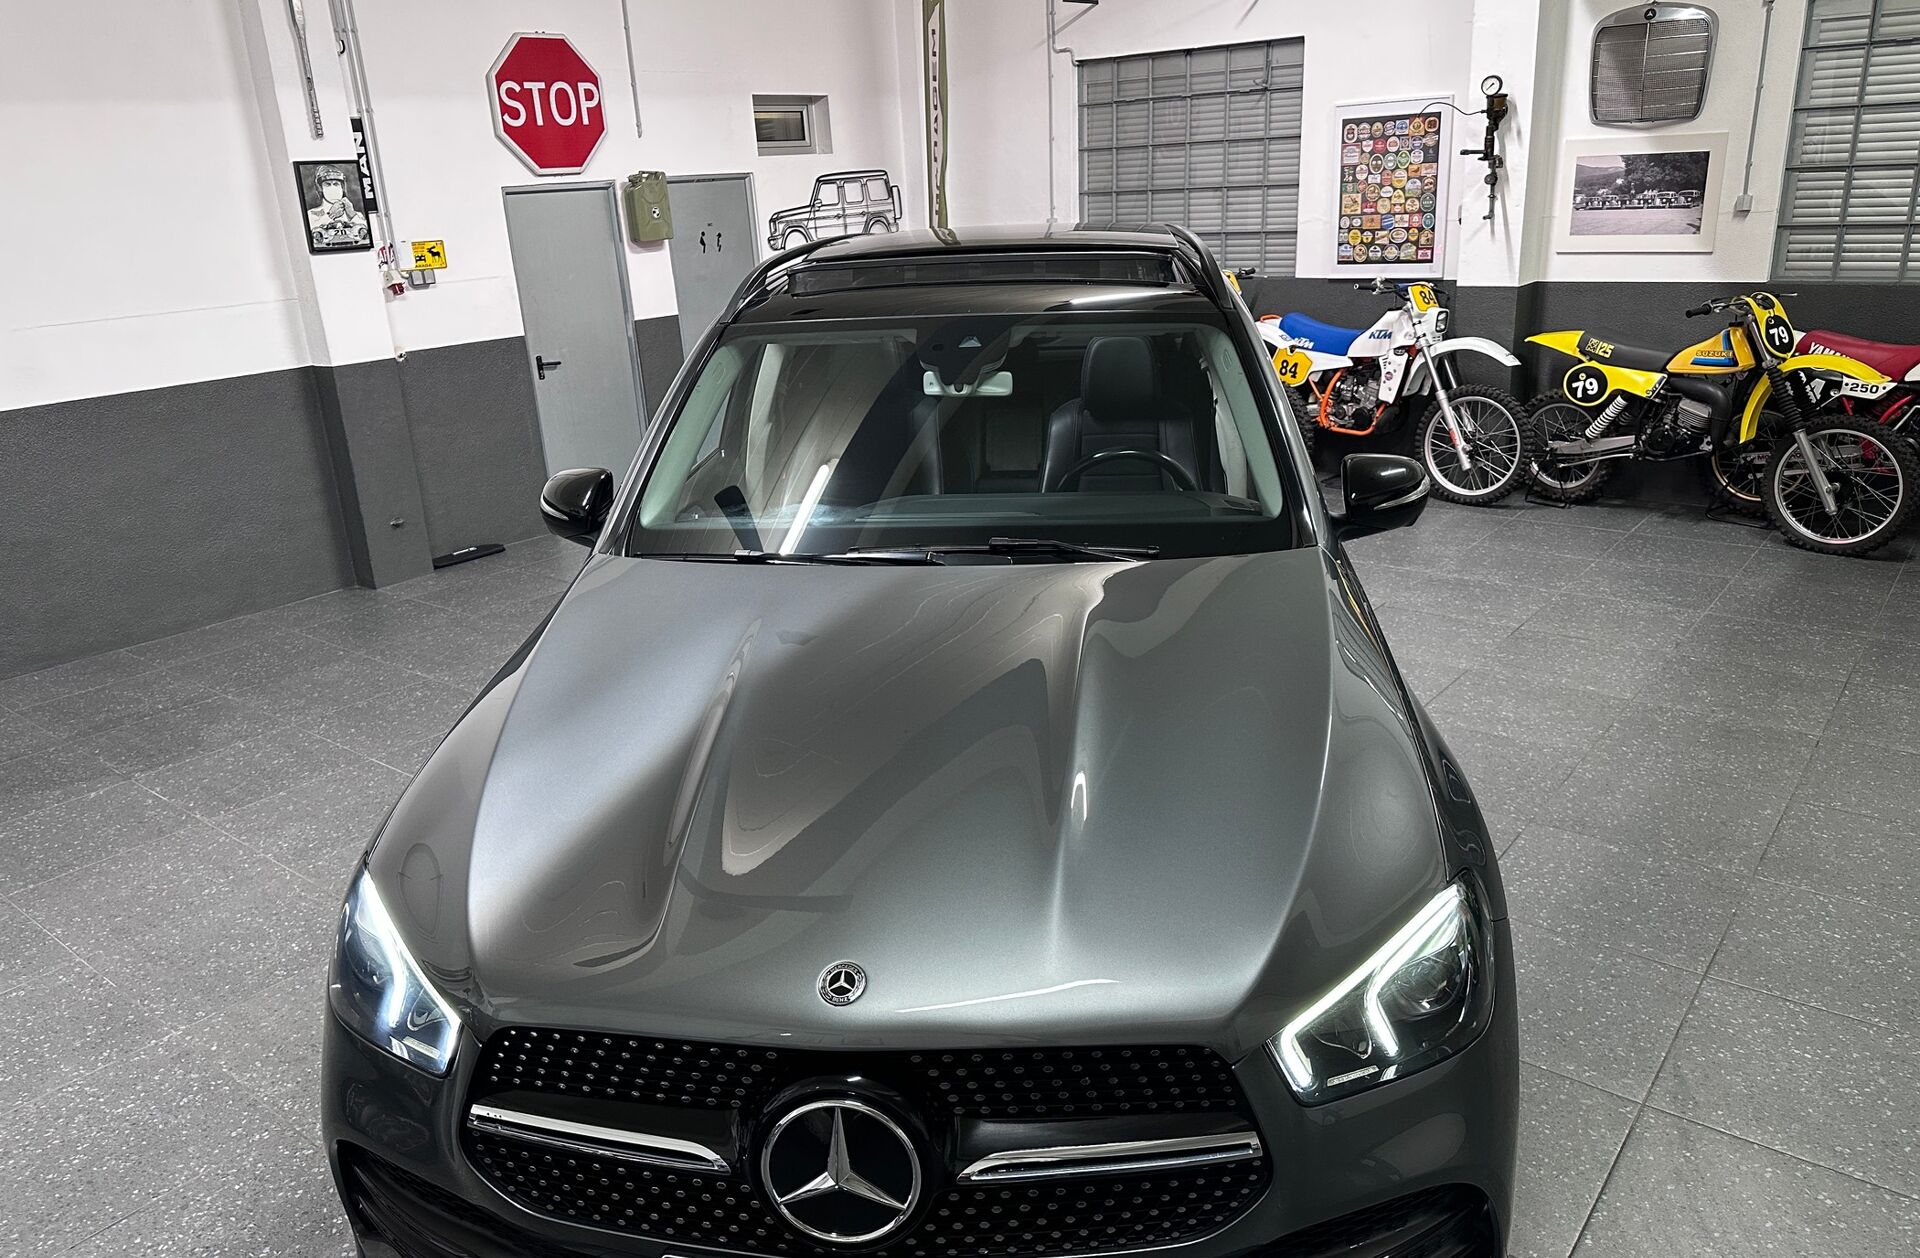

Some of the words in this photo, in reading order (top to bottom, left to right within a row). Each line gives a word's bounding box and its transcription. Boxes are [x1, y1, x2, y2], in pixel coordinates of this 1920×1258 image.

[500, 81, 600, 127] STOP
[353, 131, 375, 199] MAN
[1419, 290, 1437, 305] 84
[1368, 329, 1393, 340] KTM
[1768, 325, 1790, 346] 79
[1595, 341, 1615, 359] 125
[1695, 350, 1734, 358] SUZUKI
[1279, 359, 1299, 379] 84
[1571, 377, 1599, 399] 79
[1849, 382, 1880, 395] 250
